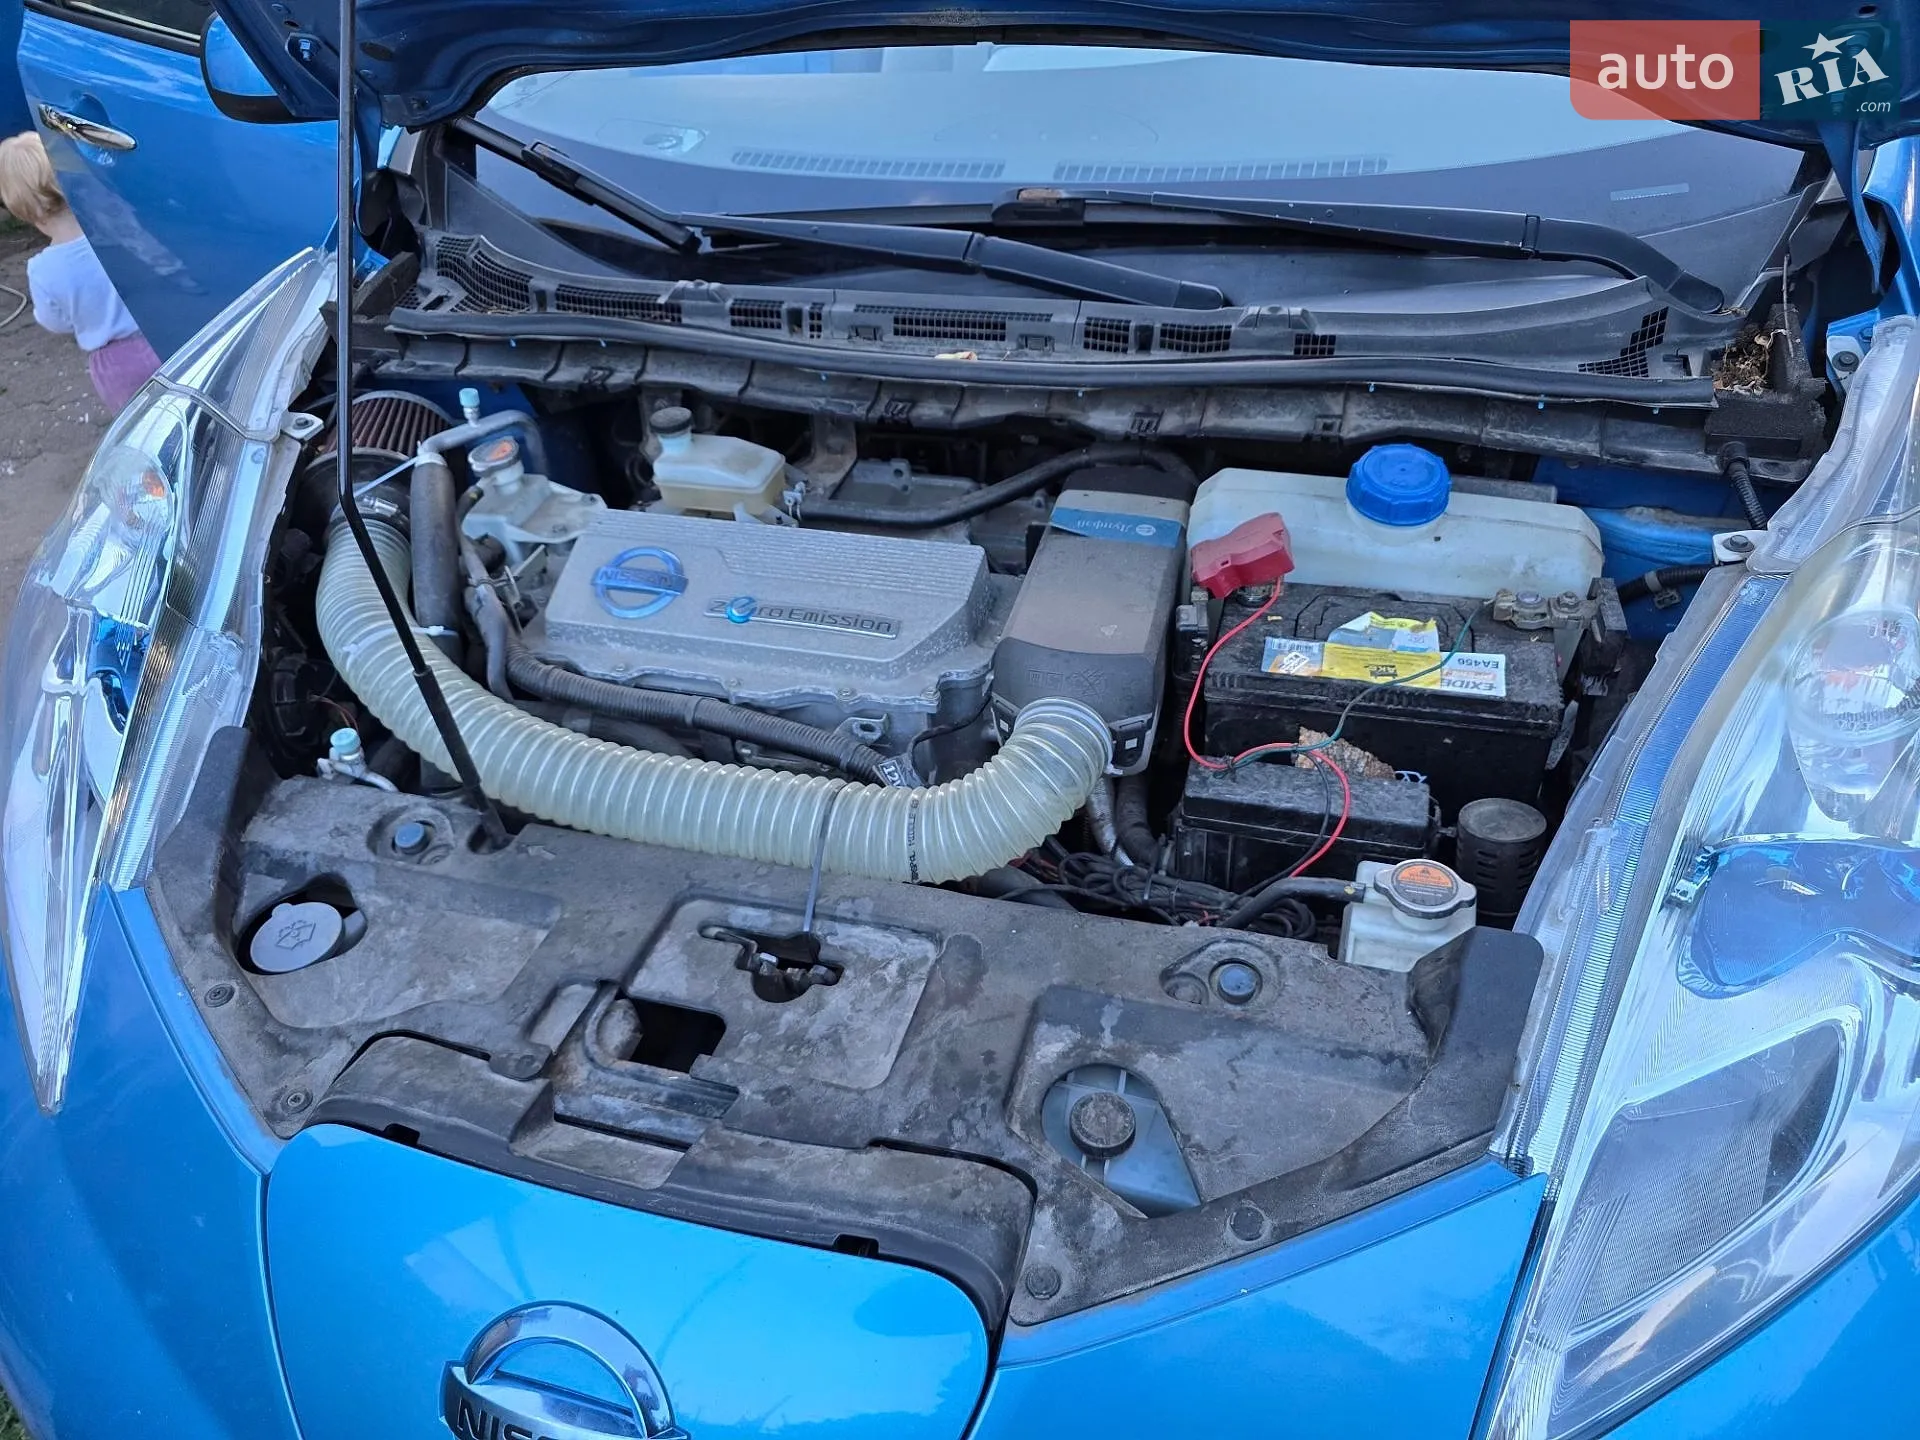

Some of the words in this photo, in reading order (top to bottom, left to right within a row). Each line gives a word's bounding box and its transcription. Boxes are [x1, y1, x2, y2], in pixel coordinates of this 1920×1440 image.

[599, 566, 674, 589] NISSAN
[788, 607, 892, 633] Emission
[1441, 678, 1496, 690] EXIDE
